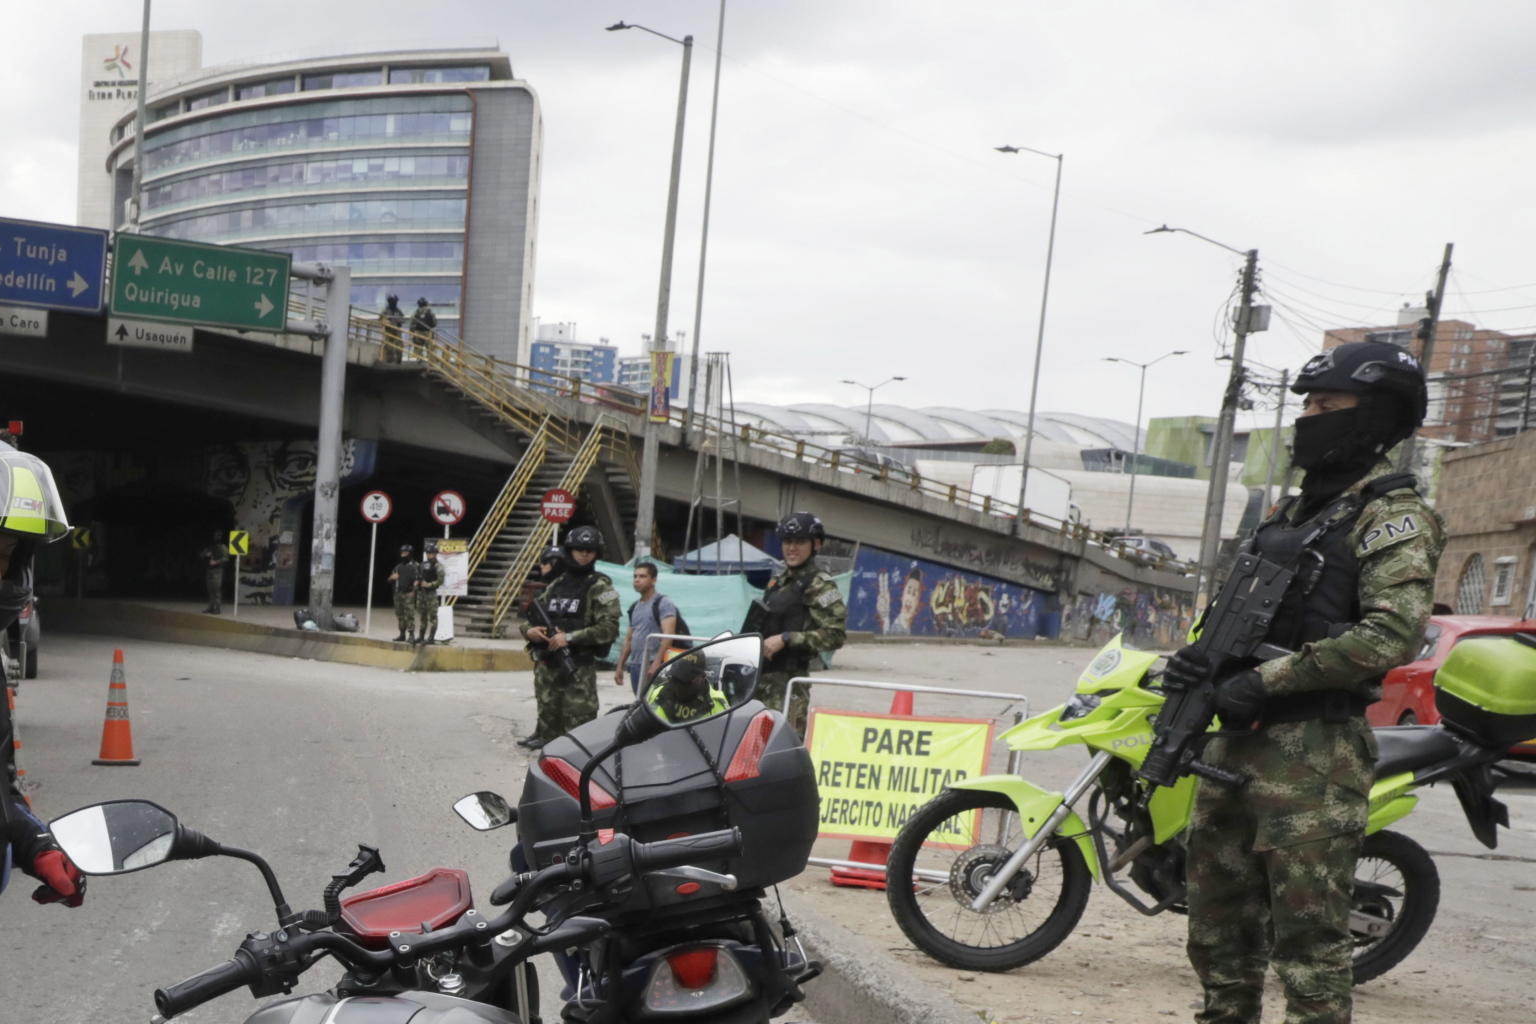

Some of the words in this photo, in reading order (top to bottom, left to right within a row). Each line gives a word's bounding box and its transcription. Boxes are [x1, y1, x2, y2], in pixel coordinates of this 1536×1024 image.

[14, 237, 67, 265] Tunja
[159, 256, 184, 276] Av
[193, 260, 237, 282] Calle
[246, 266, 279, 287] 127
[125, 283, 201, 310] Quirigua
[10, 314, 40, 330] Caro
[1398, 352, 1418, 368] PM
[551, 494, 565, 503] NO
[544, 508, 571, 518] PASE
[1360, 515, 1417, 551] PM
[861, 727, 933, 756] PARE
[818, 761, 882, 790] RETEN
[817, 797, 883, 828] JERCITO
